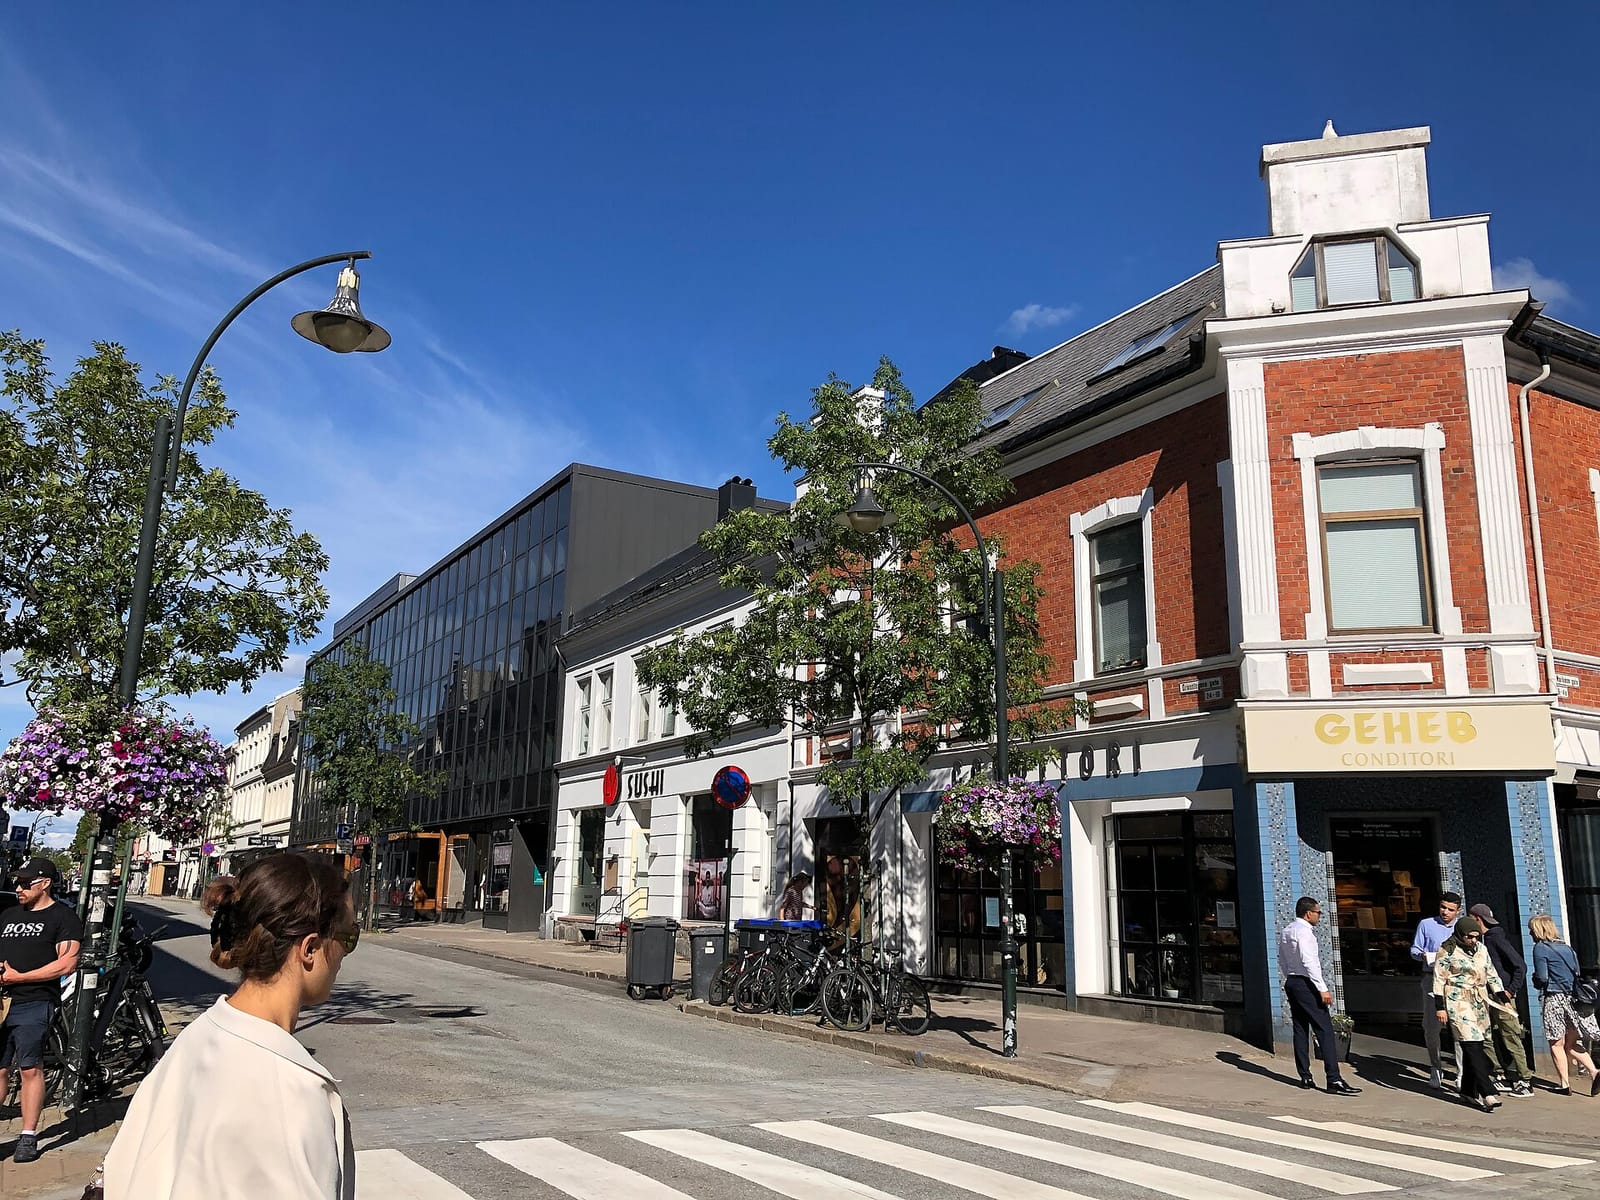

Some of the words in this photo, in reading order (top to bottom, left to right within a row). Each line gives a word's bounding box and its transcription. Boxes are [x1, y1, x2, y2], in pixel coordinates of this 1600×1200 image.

[1314, 711, 1477, 745] GEHEB
[1342, 751, 1455, 766] CONDITORI
[627, 769, 664, 799] SUSHI
[3, 922, 45, 934] BOSS
